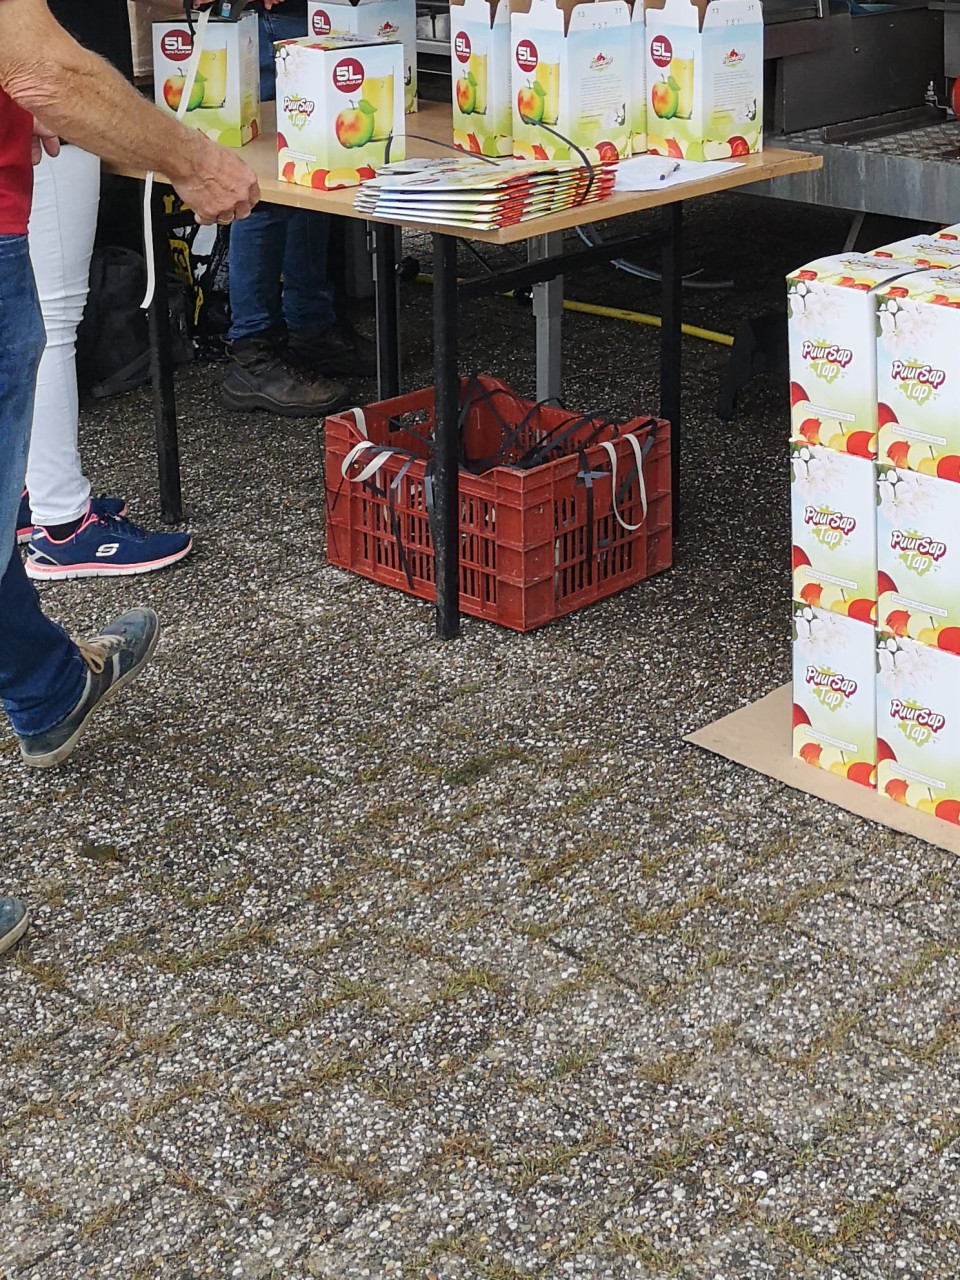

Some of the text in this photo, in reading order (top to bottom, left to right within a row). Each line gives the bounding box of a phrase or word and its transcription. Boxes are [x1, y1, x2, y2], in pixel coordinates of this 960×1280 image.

[313, 15, 330, 30] 5L
[164, 36, 192, 51] 5L
[454, 38, 470, 53] 5L
[653, 41, 672, 57] 5L
[518, 46, 537, 62] 5L
[336, 65, 363, 81] 5L
[283, 96, 315, 118] PuurSap
[802, 341, 853, 369] PuurSap
[816, 361, 836, 380] Tap
[892, 360, 946, 390] PuurSap
[904, 381, 928, 401] Tap
[805, 506, 856, 536] PuurSap
[819, 526, 839, 545] Tap
[891, 531, 947, 562] PuurSap
[904, 552, 928, 572] Tap
[806, 666, 857, 699] PuurSap
[819, 687, 839, 707] Tap
[890, 699, 945, 734] PuurSap
[905, 721, 927, 741] Tap
